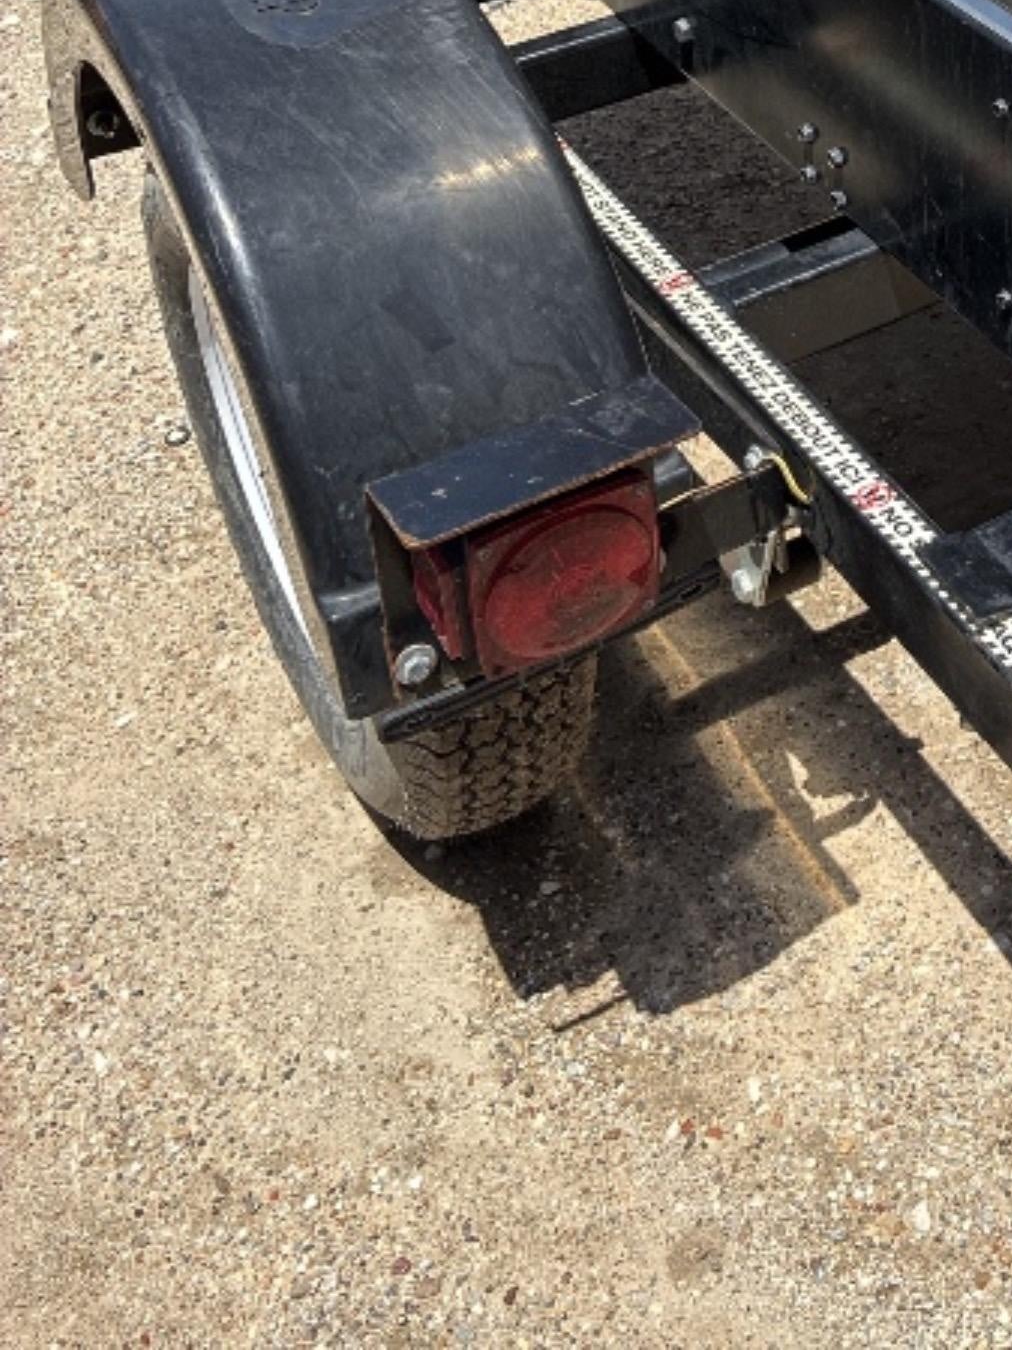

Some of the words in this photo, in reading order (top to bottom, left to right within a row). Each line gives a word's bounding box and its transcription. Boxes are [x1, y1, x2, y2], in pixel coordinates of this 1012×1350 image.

[726, 340, 778, 391] TENEZ
[770, 390, 843, 455] DEBOUT
[881, 507, 914, 538] NO
